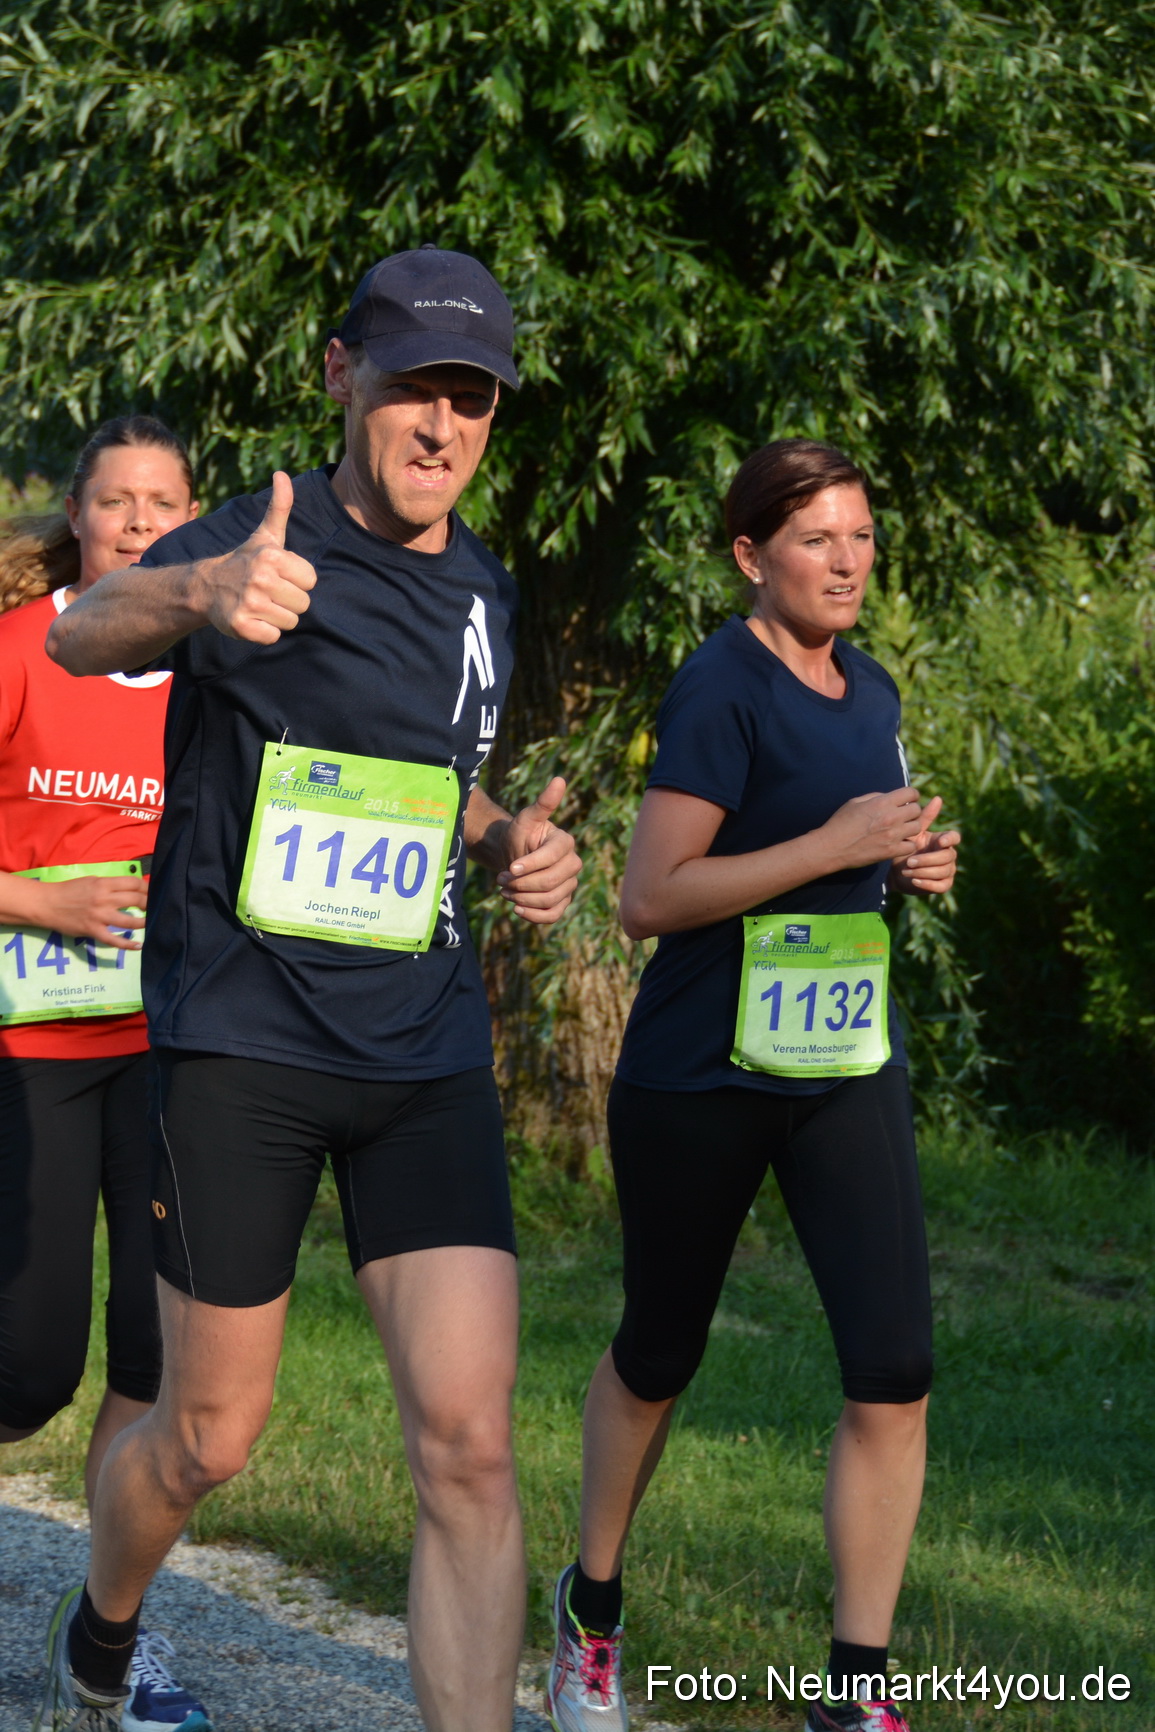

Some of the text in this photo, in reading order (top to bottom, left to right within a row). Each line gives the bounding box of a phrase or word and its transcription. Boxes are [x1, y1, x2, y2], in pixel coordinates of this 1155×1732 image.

[414, 300, 468, 310] RAIL.ONE
[27, 766, 165, 806] NEUMAR
[292, 778, 366, 801] firmenlauf
[363, 797, 400, 814] 2015
[274, 824, 428, 899] 1140
[304, 900, 381, 921] Jochen Riepl
[314, 916, 366, 930] RAIL.ONE GmbH
[4, 924, 135, 980] 1417
[771, 940, 832, 955] firmenlauf
[42, 984, 106, 998] Kristina Fink
[760, 978, 874, 1032] 1132
[772, 1043, 857, 1054] Verena Moosburger
